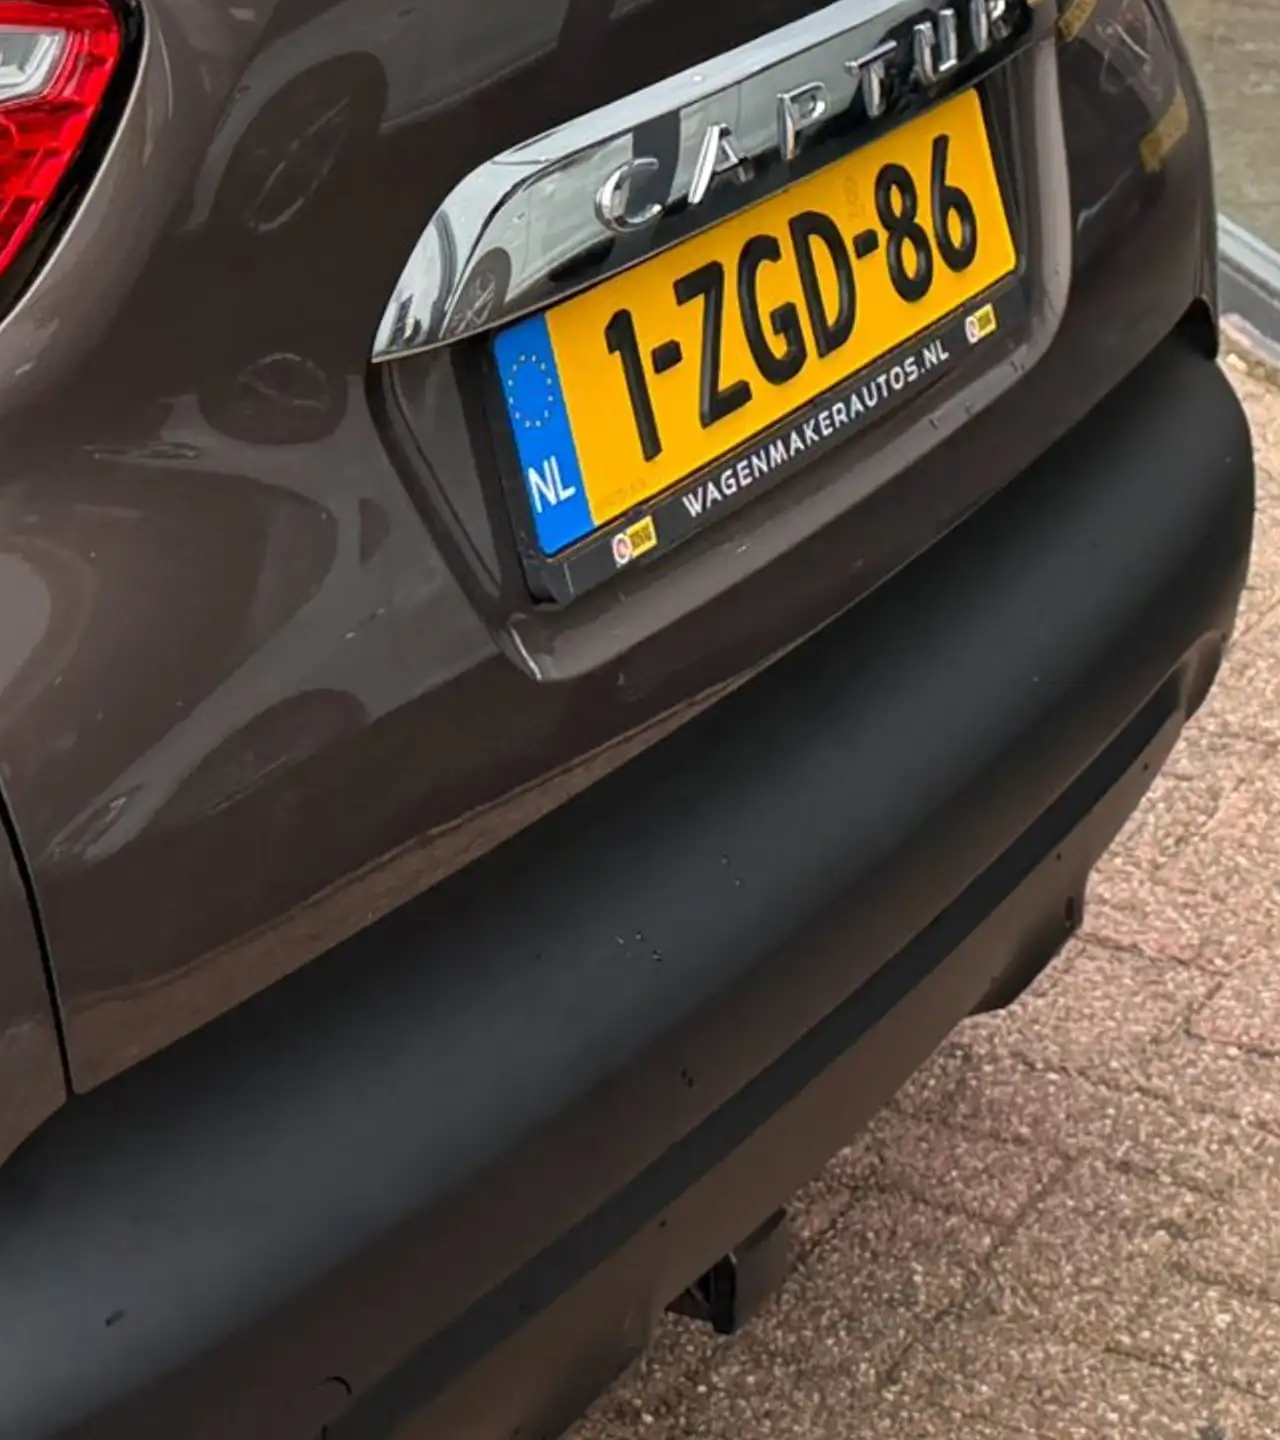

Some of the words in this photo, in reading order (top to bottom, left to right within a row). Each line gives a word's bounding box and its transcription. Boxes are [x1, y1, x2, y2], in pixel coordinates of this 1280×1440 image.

[605, 134, 978, 462] 1-ZGD-86
[527, 454, 576, 513] NL
[681, 341, 950, 517] WAGENMAKERAUTOS.NL
